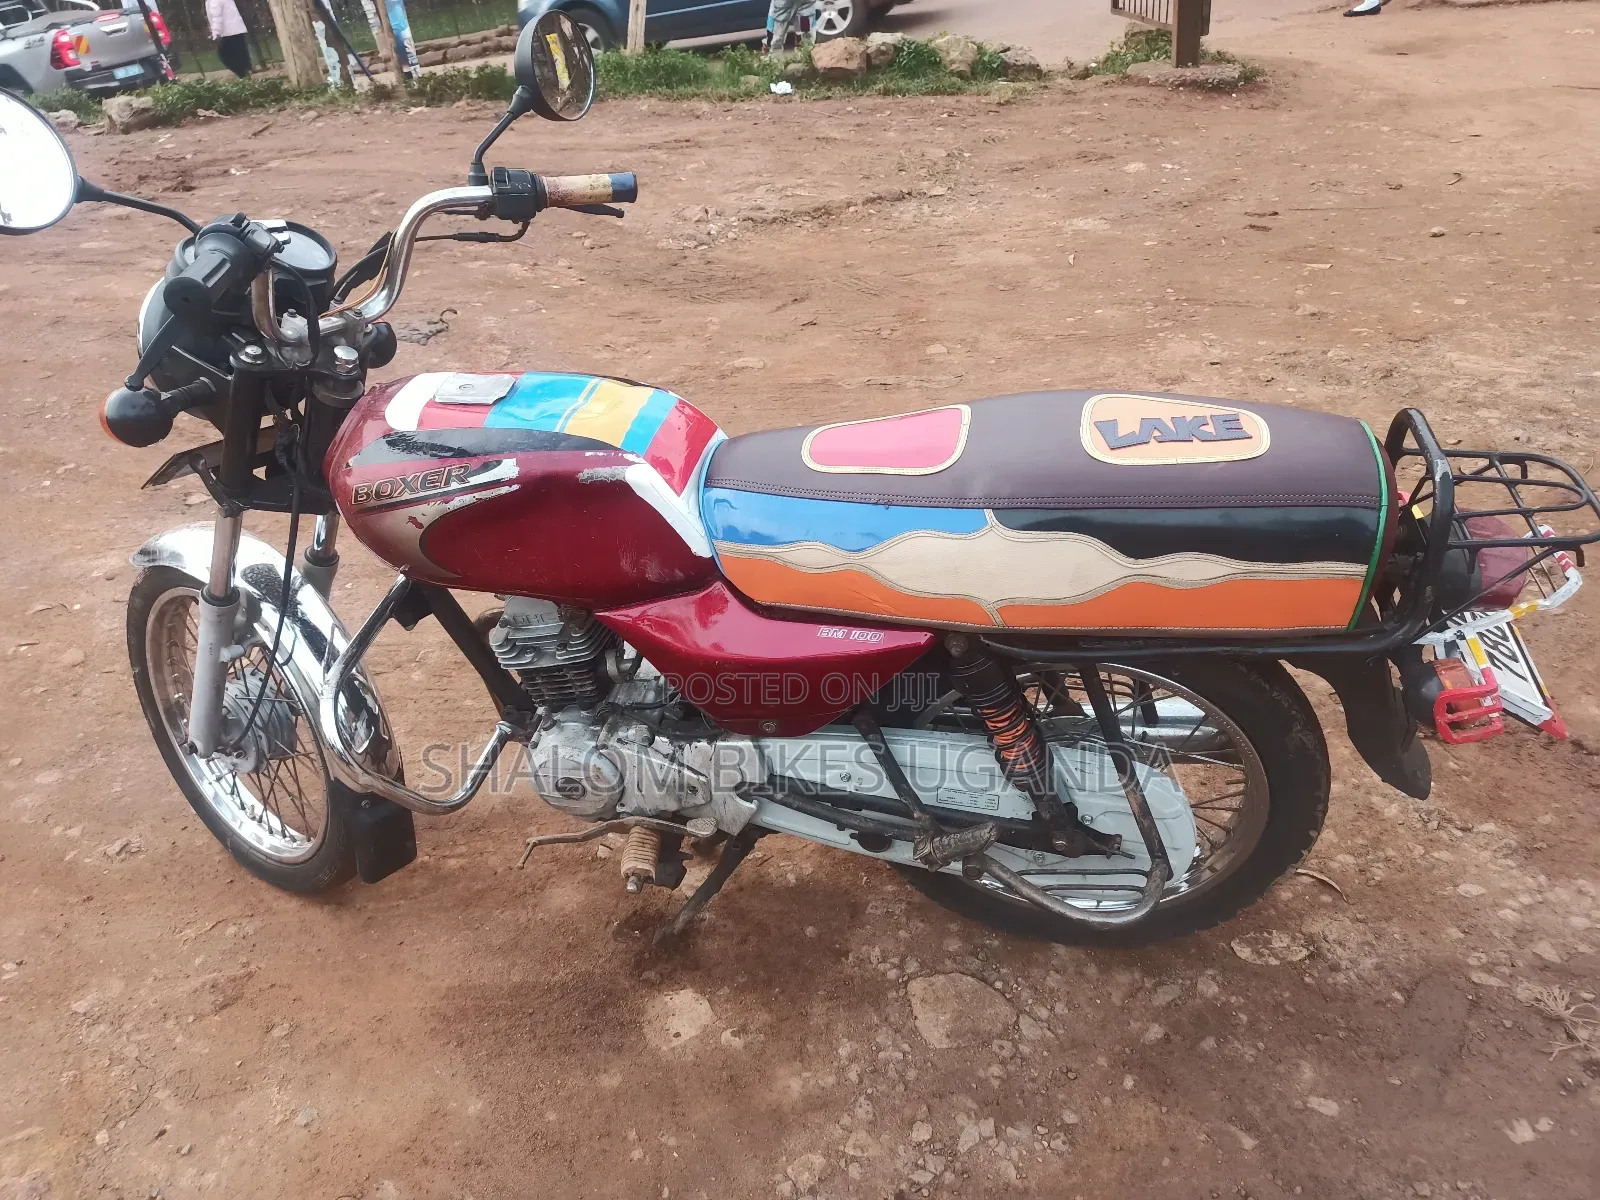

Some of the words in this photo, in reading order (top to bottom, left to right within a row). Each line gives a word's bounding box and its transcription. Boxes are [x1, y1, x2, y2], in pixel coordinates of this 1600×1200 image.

[1093, 413, 1252, 450] LAKE
[351, 463, 471, 505] BOXER
[817, 627, 848, 639] BM
[850, 630, 883, 642] 100
